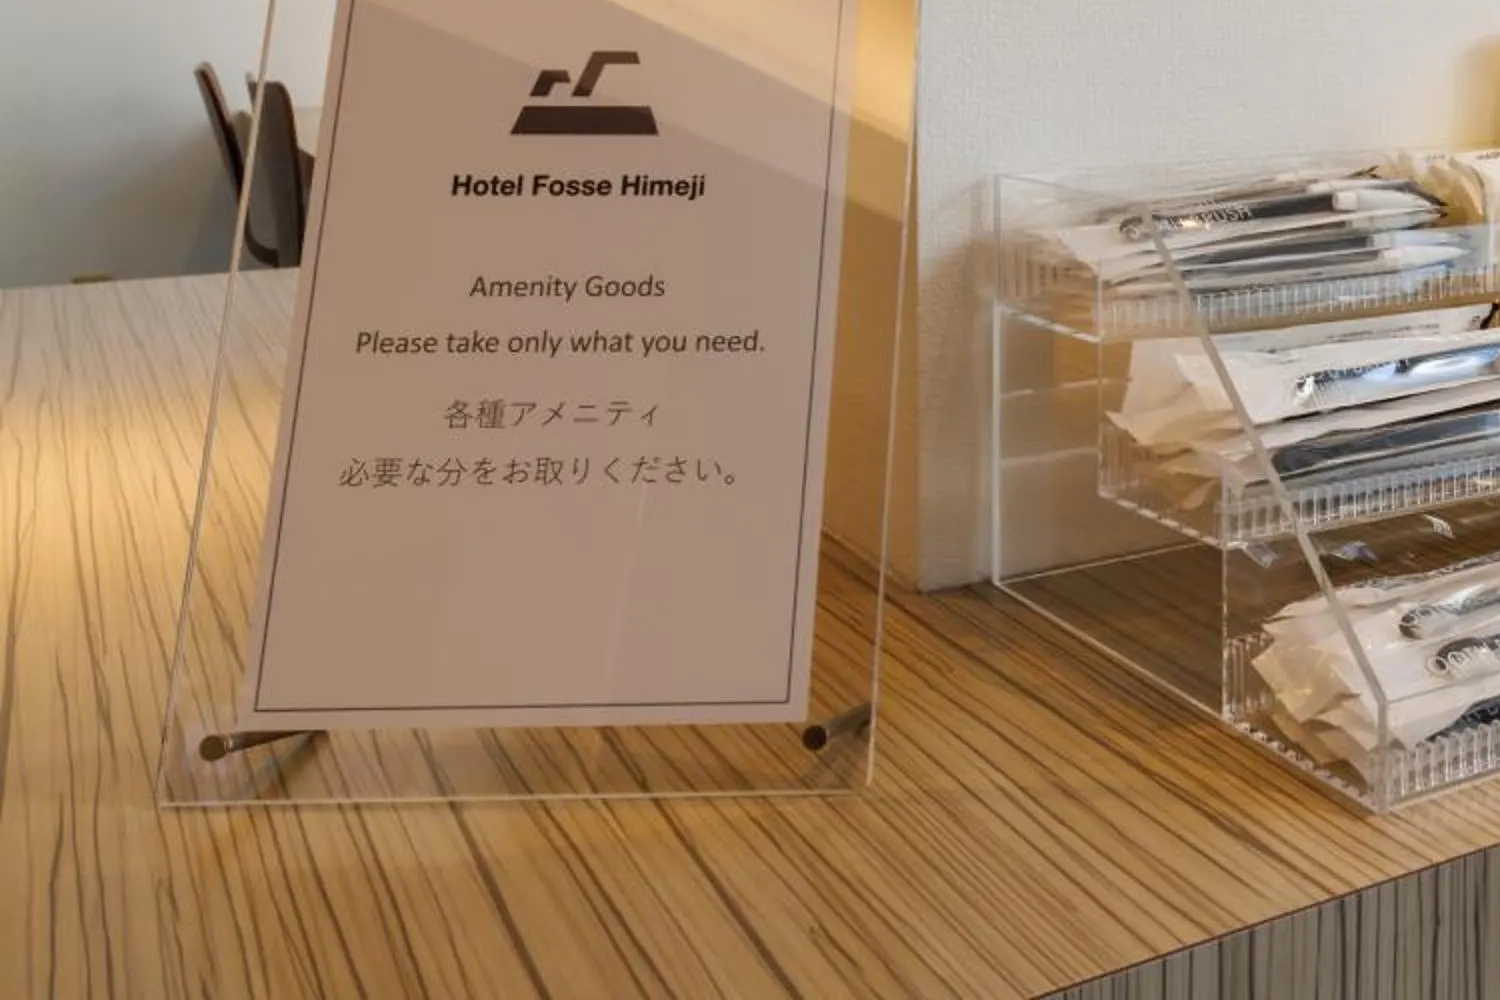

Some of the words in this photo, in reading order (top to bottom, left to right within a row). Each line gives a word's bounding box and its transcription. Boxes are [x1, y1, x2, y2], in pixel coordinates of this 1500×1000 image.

[451, 174, 524, 197] Hotel
[531, 174, 612, 197] Fosse
[620, 174, 706, 201] Himeji
[469, 274, 578, 302] Amenity
[585, 274, 666, 298] Goods
[355, 331, 438, 354] Please
[446, 331, 500, 354] take
[507, 329, 562, 358] only
[570, 330, 634, 353] what
[641, 334, 687, 358] you
[695, 330, 766, 352] need.
[444, 398, 661, 430] 各種アメニティ
[338, 455, 737, 488] 必要な分をお取りください。
